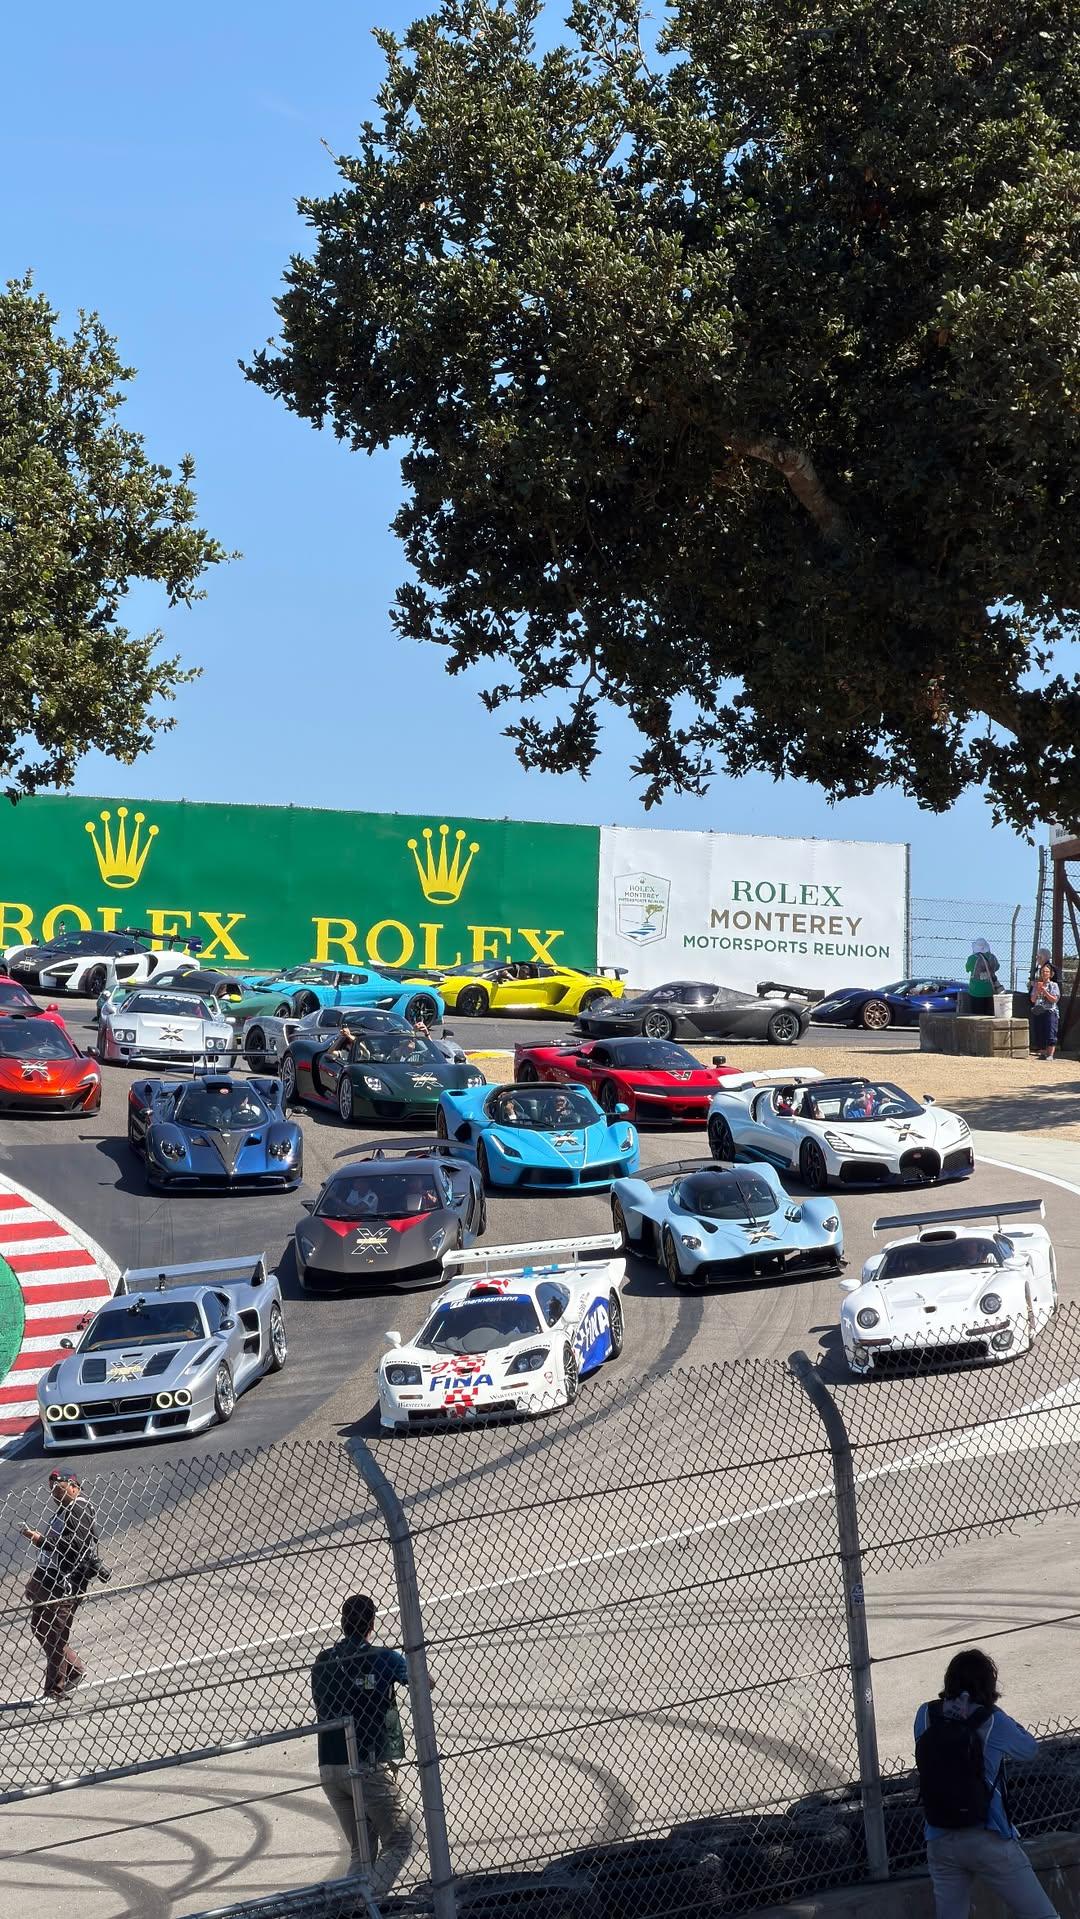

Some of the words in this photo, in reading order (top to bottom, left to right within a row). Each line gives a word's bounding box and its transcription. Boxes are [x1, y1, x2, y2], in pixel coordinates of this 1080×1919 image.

[731, 880, 844, 907] ROLEX
[710, 909, 863, 937] MONTEREY
[310, 917, 570, 970] ROLEX
[683, 935, 808, 955] MOTORSPORTS
[813, 942, 890, 959] REUNION
[429, 1373, 494, 1392] FINA
